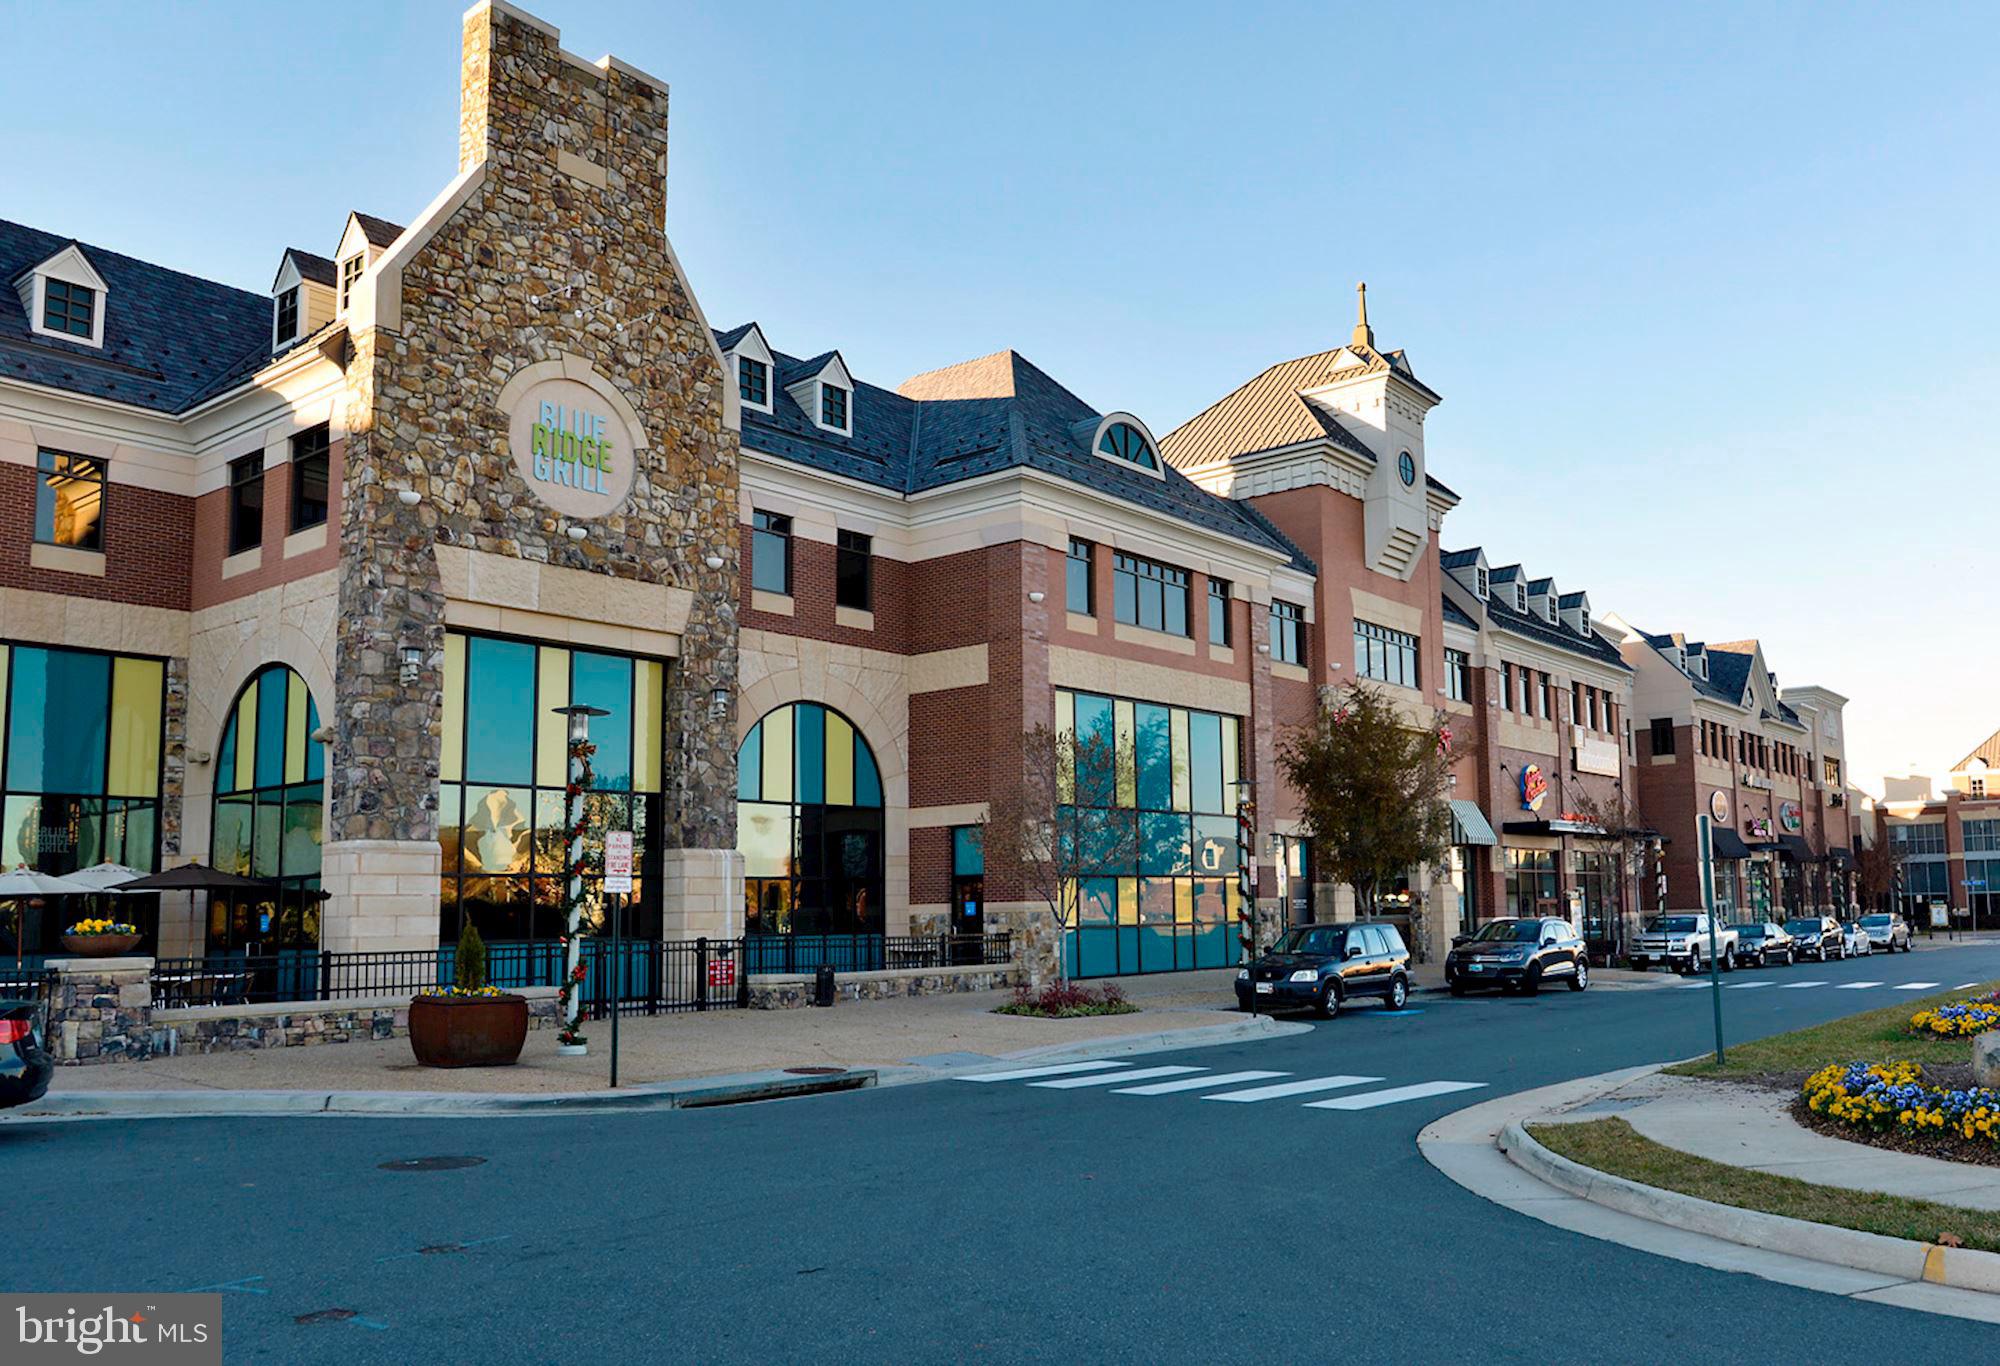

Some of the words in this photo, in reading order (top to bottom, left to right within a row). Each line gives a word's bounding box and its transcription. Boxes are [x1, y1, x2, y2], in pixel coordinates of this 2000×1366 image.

[540, 400, 607, 447] BLUE
[532, 423, 614, 473] RIDGE
[533, 448, 609, 495] GRILL
[40, 826, 68, 837] BLUE
